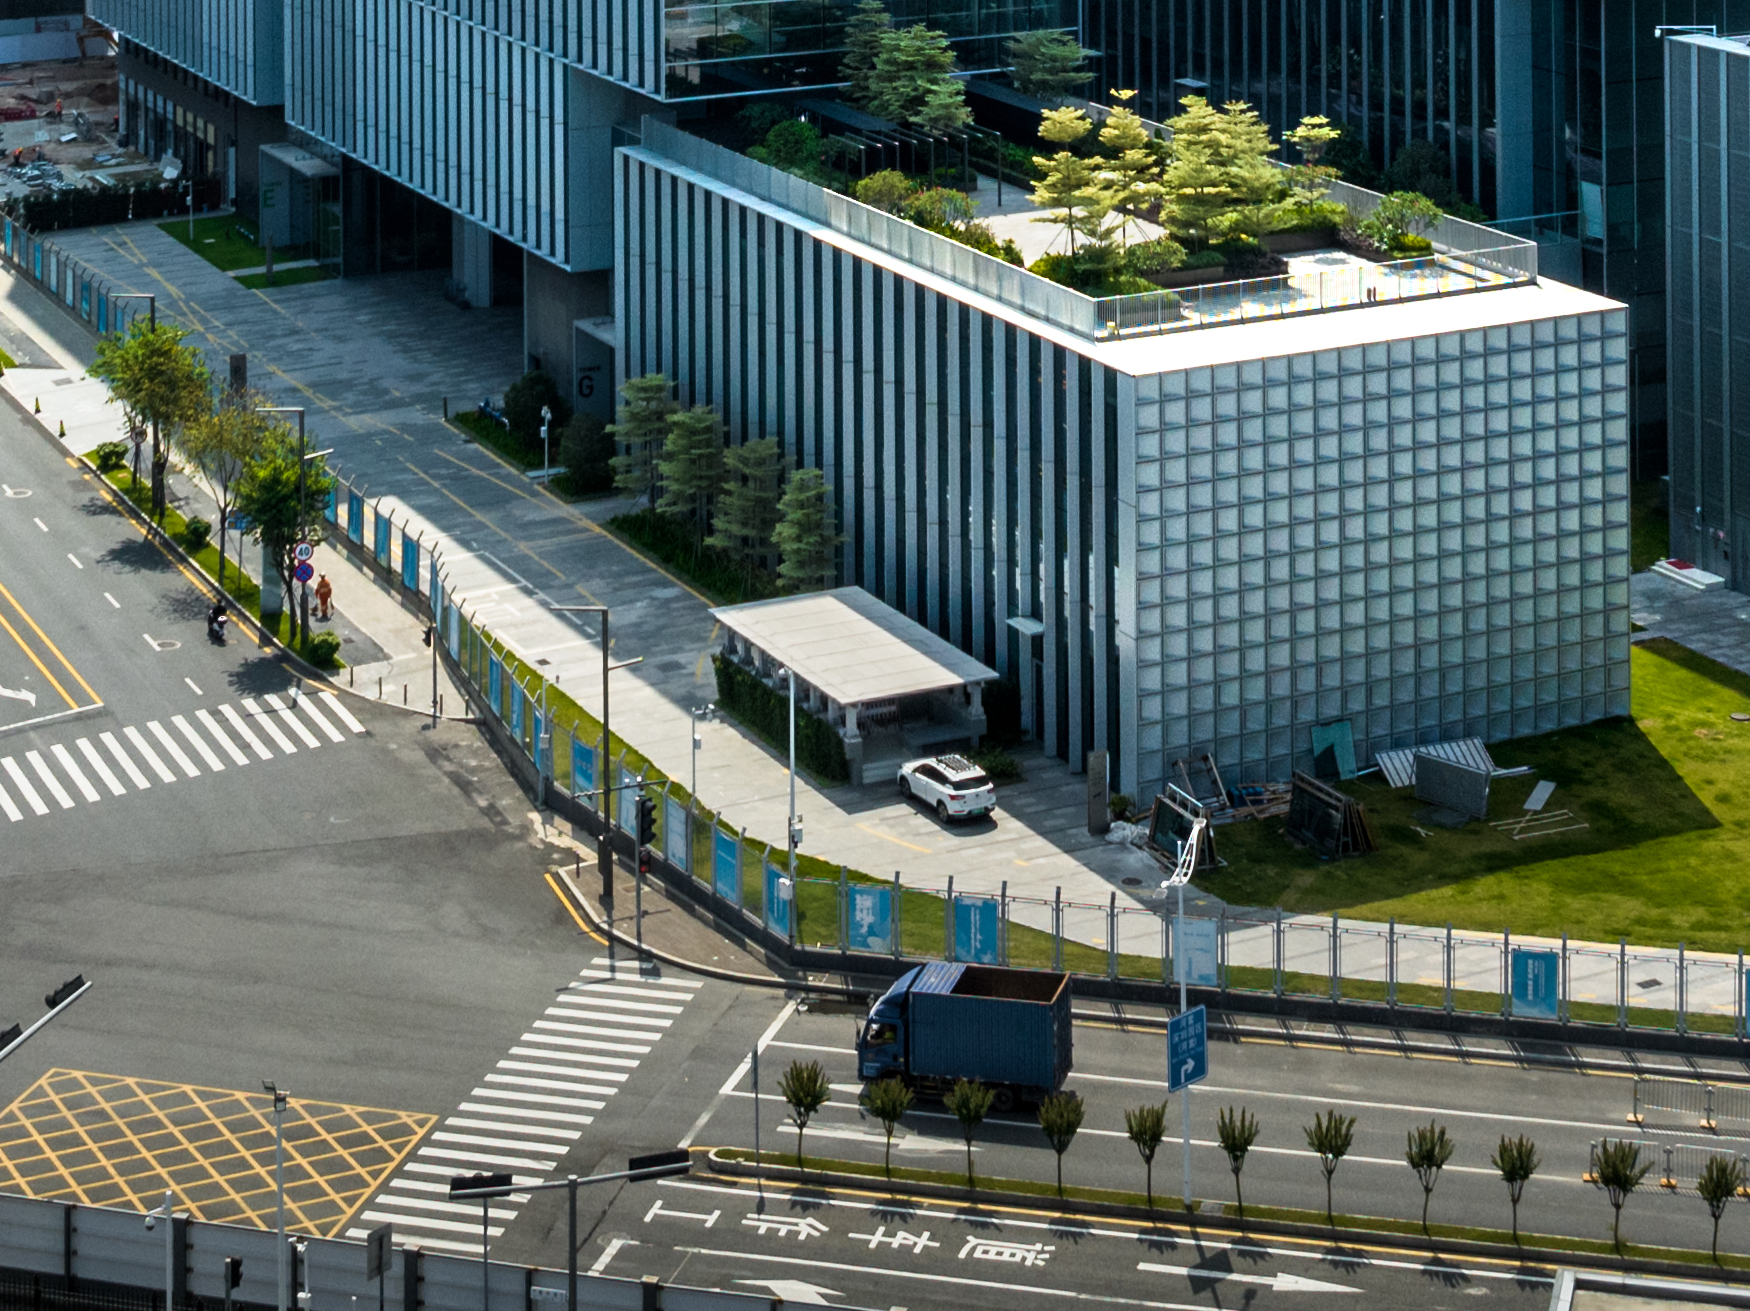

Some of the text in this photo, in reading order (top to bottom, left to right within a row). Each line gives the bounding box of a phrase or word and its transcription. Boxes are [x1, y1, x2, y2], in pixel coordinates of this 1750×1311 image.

[263, 189, 275, 208] E
[579, 375, 594, 397] G
[298, 546, 310, 556] 40
[644, 1199, 1055, 1266] 工作车道
